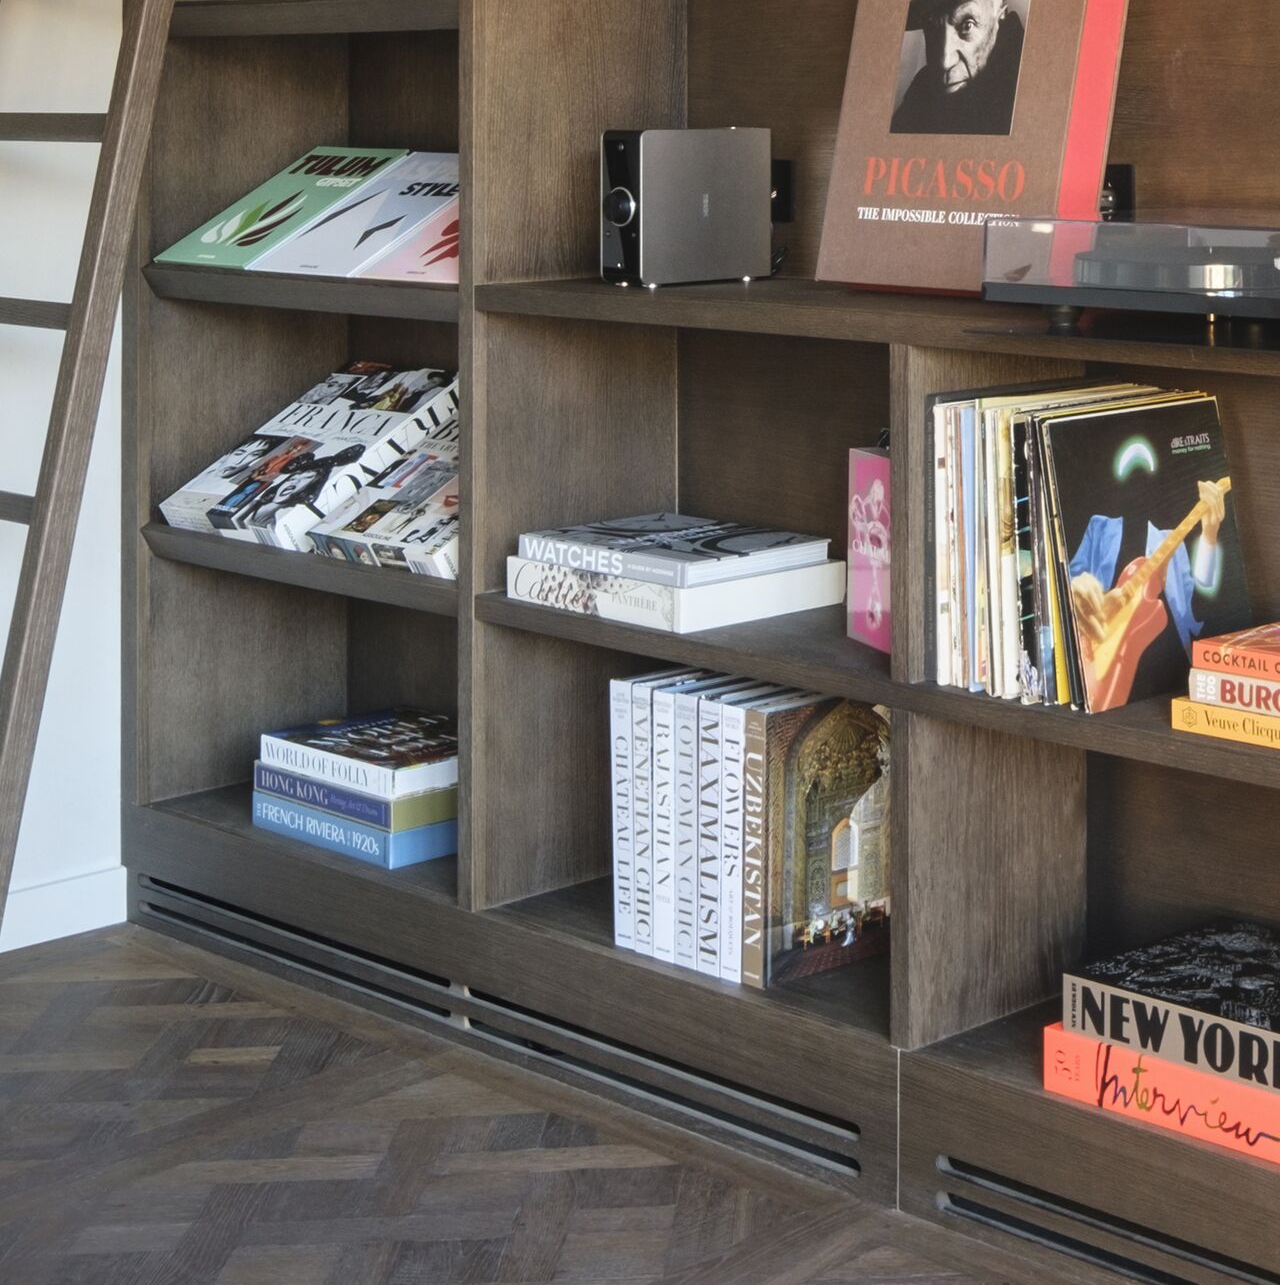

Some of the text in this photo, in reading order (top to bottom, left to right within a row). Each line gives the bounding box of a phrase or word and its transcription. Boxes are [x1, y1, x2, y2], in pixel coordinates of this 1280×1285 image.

[288, 155, 391, 177] TULUM
[863, 156, 1026, 203] PICASSO
[857, 206, 879, 220] THE
[881, 207, 945, 225] IMPOSSIBLE
[525, 537, 624, 575] WATCHES
[515, 562, 597, 610] Cartier
[1203, 650, 1269, 672] COCKTAIL
[1197, 674, 1206, 699] THE
[1206, 676, 1216, 700] 100
[1204, 710, 1241, 733] Veuve
[261, 770, 328, 806] HONG KONG
[265, 742, 369, 788] WORLD OF FOLLY
[634, 716, 651, 938] VENETIAN CHIC
[656, 722, 671, 886] RAJASTHAN
[724, 738, 740, 877] FLOWERS
[262, 803, 303, 831] FRENCH
[306, 816, 345, 844] RIVIERA
[352, 831, 380, 856] 1920s
[678, 725, 694, 949] OTTOMAN CHIC
[699, 716, 720, 955] MAXIMALISM
[743, 751, 763, 949] UZBEKISTAN
[617, 859, 631, 914] LIFE
[1081, 985, 1170, 1054] NEW
